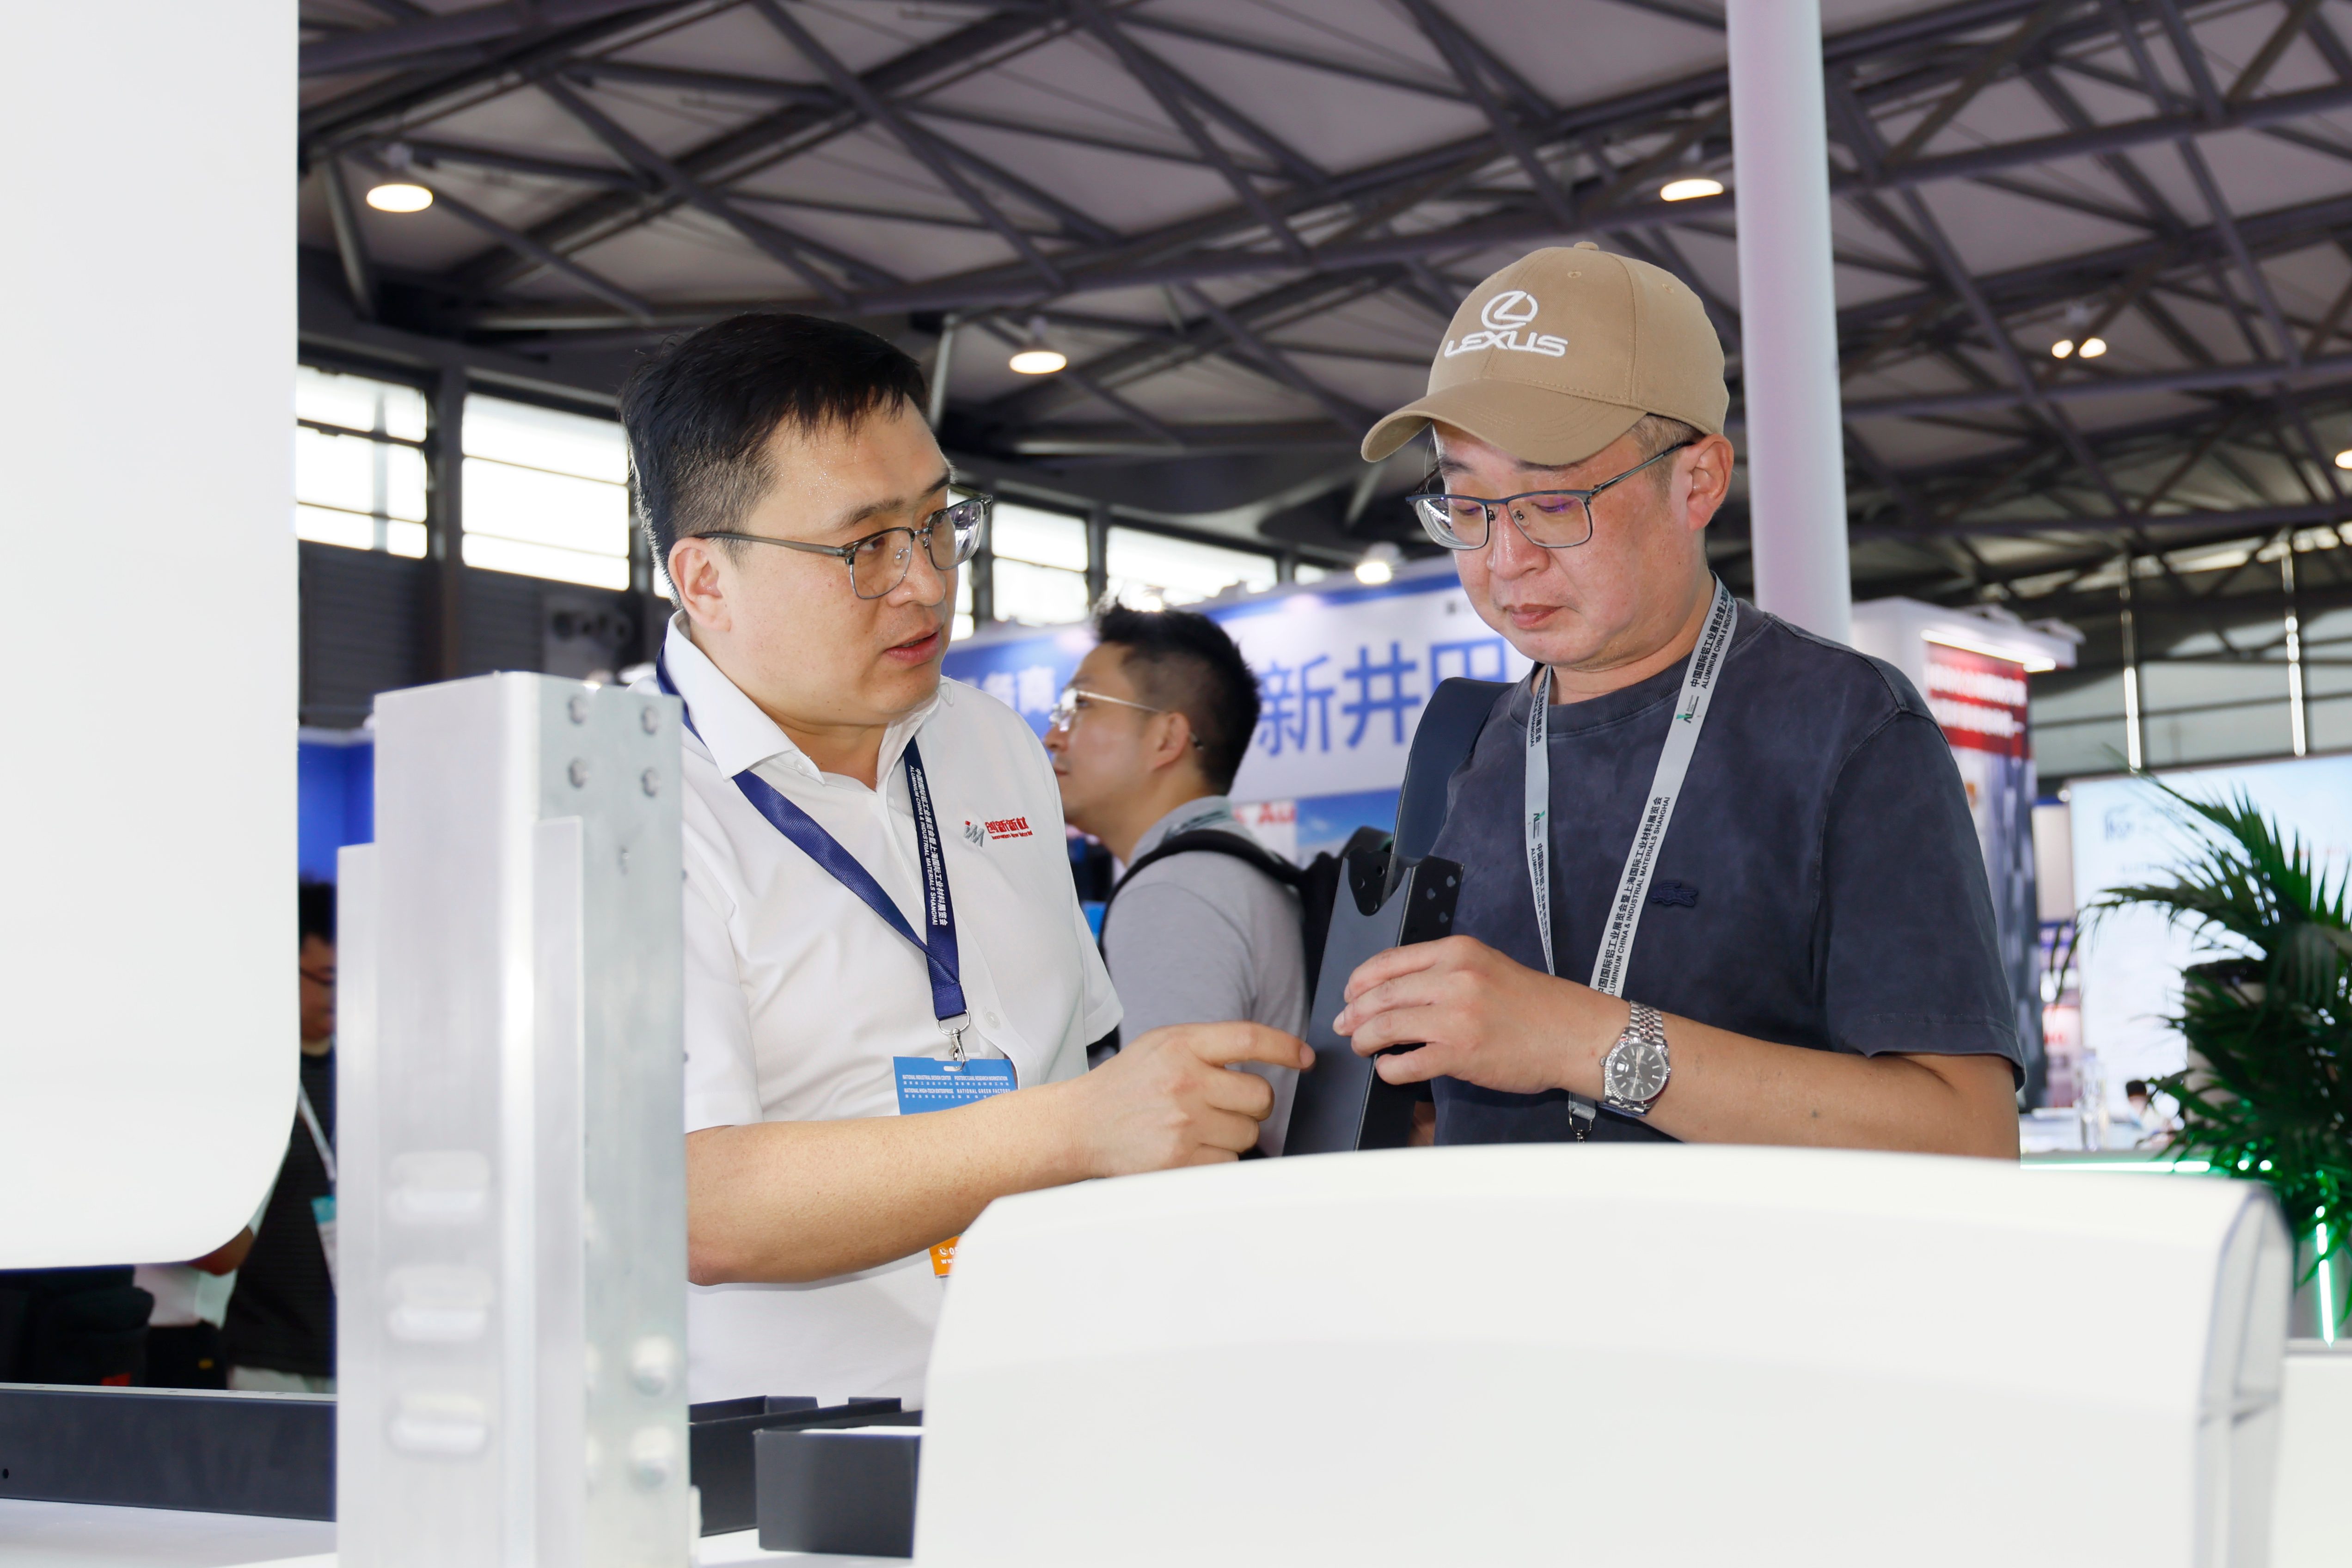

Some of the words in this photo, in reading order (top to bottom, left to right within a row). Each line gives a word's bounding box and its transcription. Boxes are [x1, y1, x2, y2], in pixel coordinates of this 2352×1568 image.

[1444, 330, 1568, 358] LEXUS
[1701, 653, 1718, 689] ALUMINIUM
[1714, 635, 1726, 652] CHINA
[909, 765, 920, 797] ALUMINIUM
[920, 821, 930, 856] INDUSTRIAL
[925, 858, 936, 891] MATERIALS
[930, 892, 938, 925] SHANGHAI
[1608, 956, 1623, 995] LUMINIUM
[1618, 930, 1629, 954] CHINA
[1626, 878, 1644, 921] INDUSTRIAL
[1640, 836, 1657, 876] MATERIALS
[1654, 797, 1671, 834] SHANGHAI
